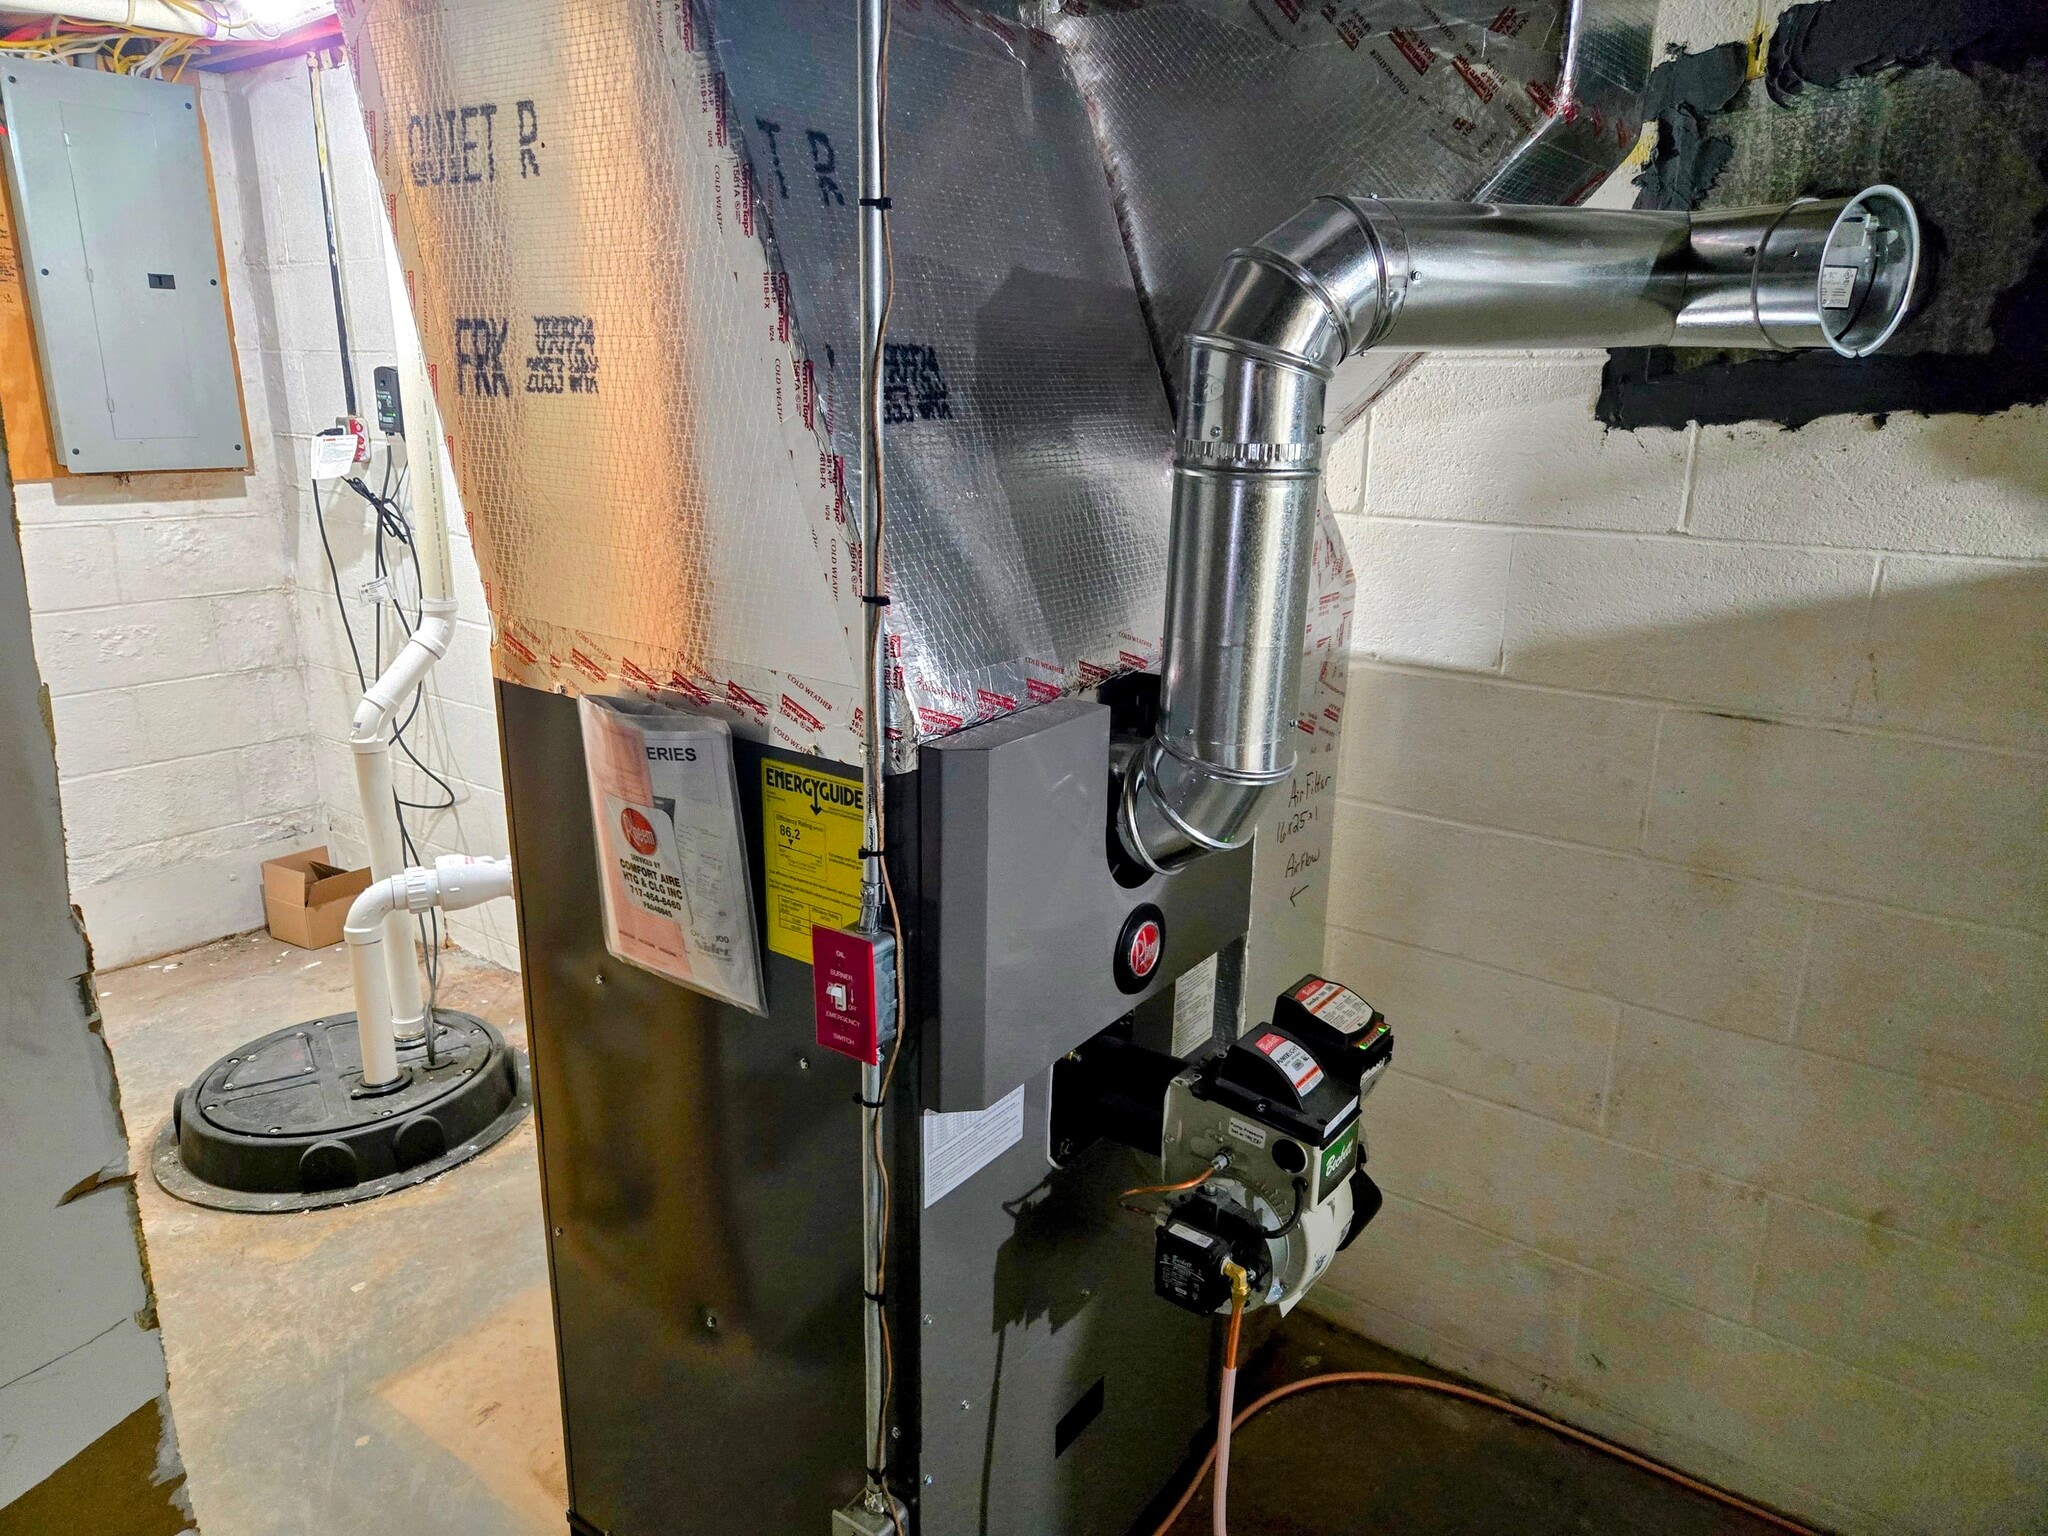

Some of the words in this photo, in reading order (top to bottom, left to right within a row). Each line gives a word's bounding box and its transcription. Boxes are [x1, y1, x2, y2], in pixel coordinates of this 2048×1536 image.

[714, 72, 724, 149] VentureTape
[714, 164, 722, 193] COLD
[733, 163, 741, 198] 1581A
[742, 163, 751, 239] VentureTape
[778, 272, 787, 344] VentureTape
[802, 359, 811, 431] VentureTape
[787, 674, 806, 692] COLD
[804, 686, 833, 712] WEATHER
[773, 726, 792, 745] COLD
[647, 746, 697, 762] ERIES
[779, 825, 801, 841] 86.2
[619, 858, 658, 881] COMFORT
[660, 874, 681, 888] AIRE
[622, 871, 640, 885] HTG
[640, 879, 648, 888] &
[648, 880, 667, 894] CLG
[667, 887, 683, 900] INC
[835, 950, 846, 959] OIL
[830, 969, 853, 981] BURNER
[826, 1011, 860, 1028] EMERGENCY
[833, 1032, 855, 1046] SWITCH
[1325, 1138, 1354, 1178] Beckett
